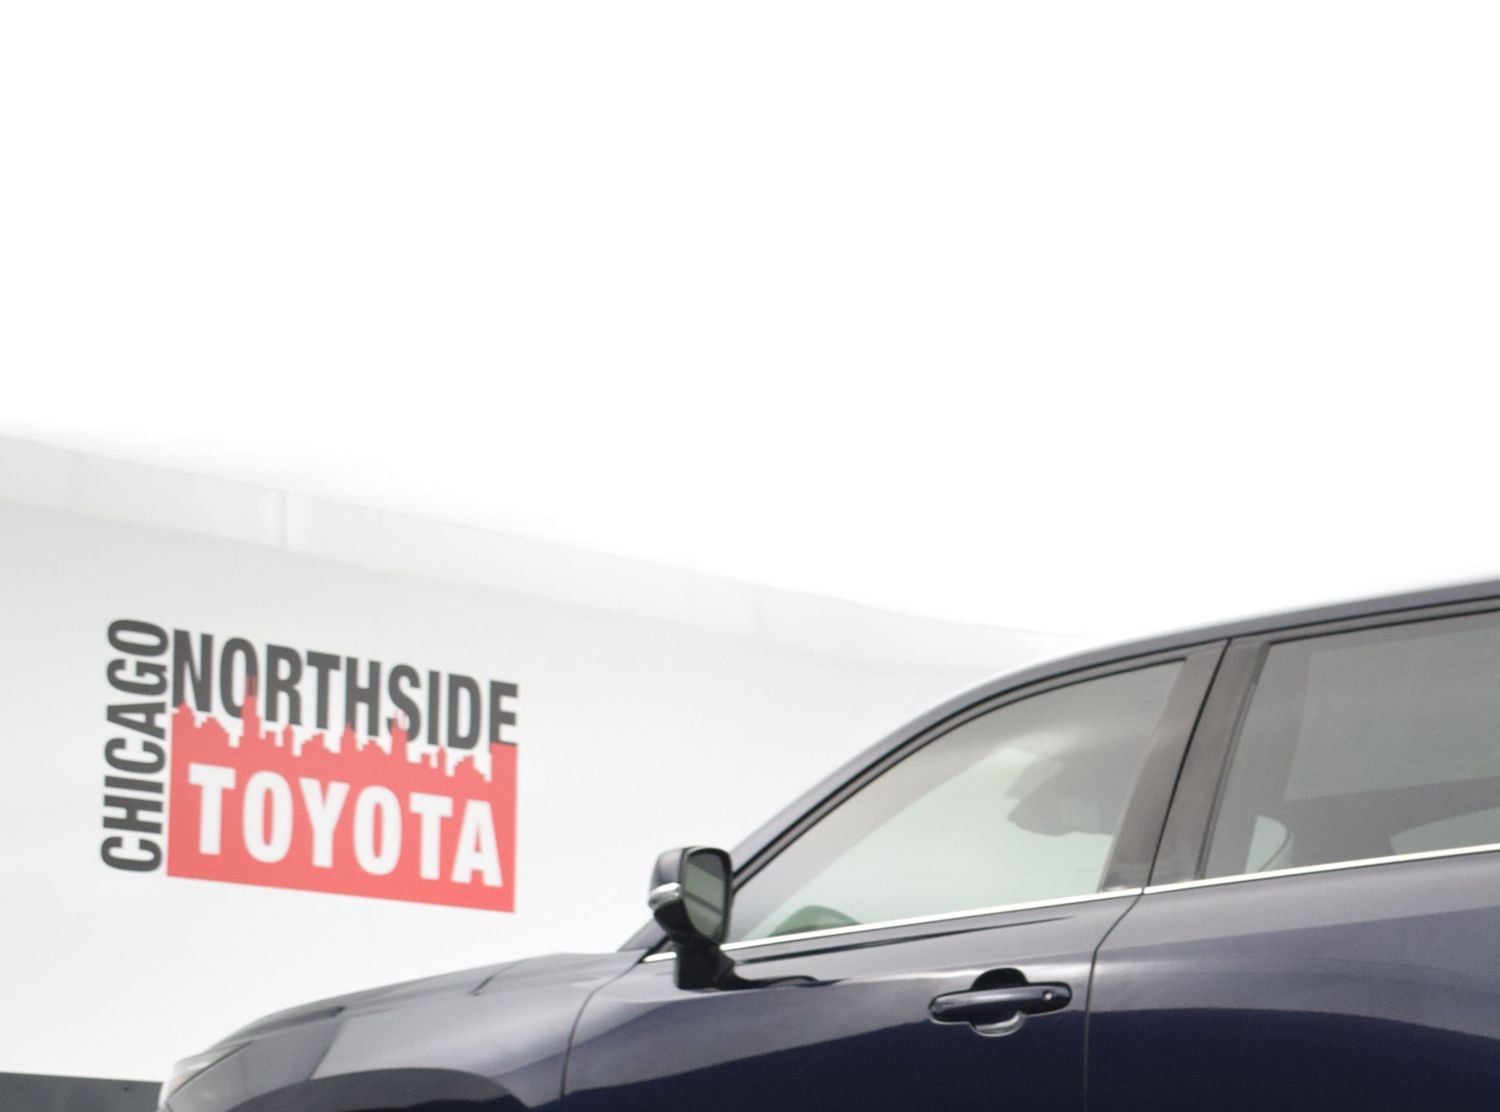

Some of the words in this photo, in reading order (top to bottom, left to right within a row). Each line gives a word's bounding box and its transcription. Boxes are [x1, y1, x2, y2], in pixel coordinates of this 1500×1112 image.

[100, 619, 169, 872] CHICAGO
[172, 629, 519, 751] NORTHSIDE
[188, 763, 504, 887] TOYOTA
